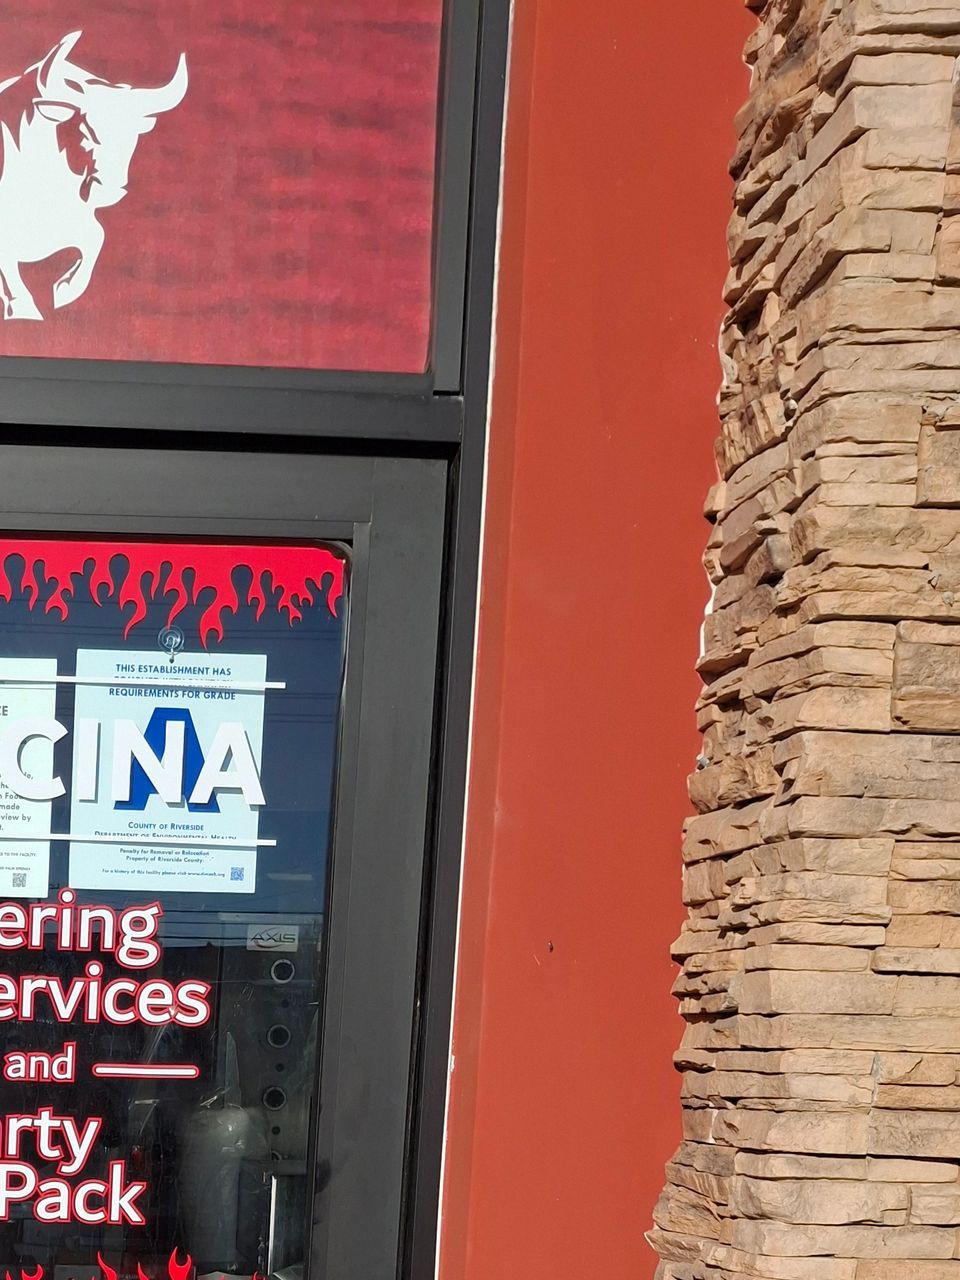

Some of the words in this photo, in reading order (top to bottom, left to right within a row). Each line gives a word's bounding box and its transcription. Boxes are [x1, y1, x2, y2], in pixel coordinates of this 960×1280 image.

[116, 664, 135, 672] THIS
[138, 664, 210, 675] ESTABLISHMENT
[212, 667, 232, 676] HAS
[109, 688, 178, 698] REQUIREMENTS
[182, 690, 200, 699] FOR
[204, 691, 236, 700] GRADE
[22, 814, 32, 822] by
[128, 821, 156, 830] COUNTY
[170, 822, 204, 831] RIVERSIDE
[250, 932, 296, 943] AXIS
[3, 1041, 76, 1082] and
